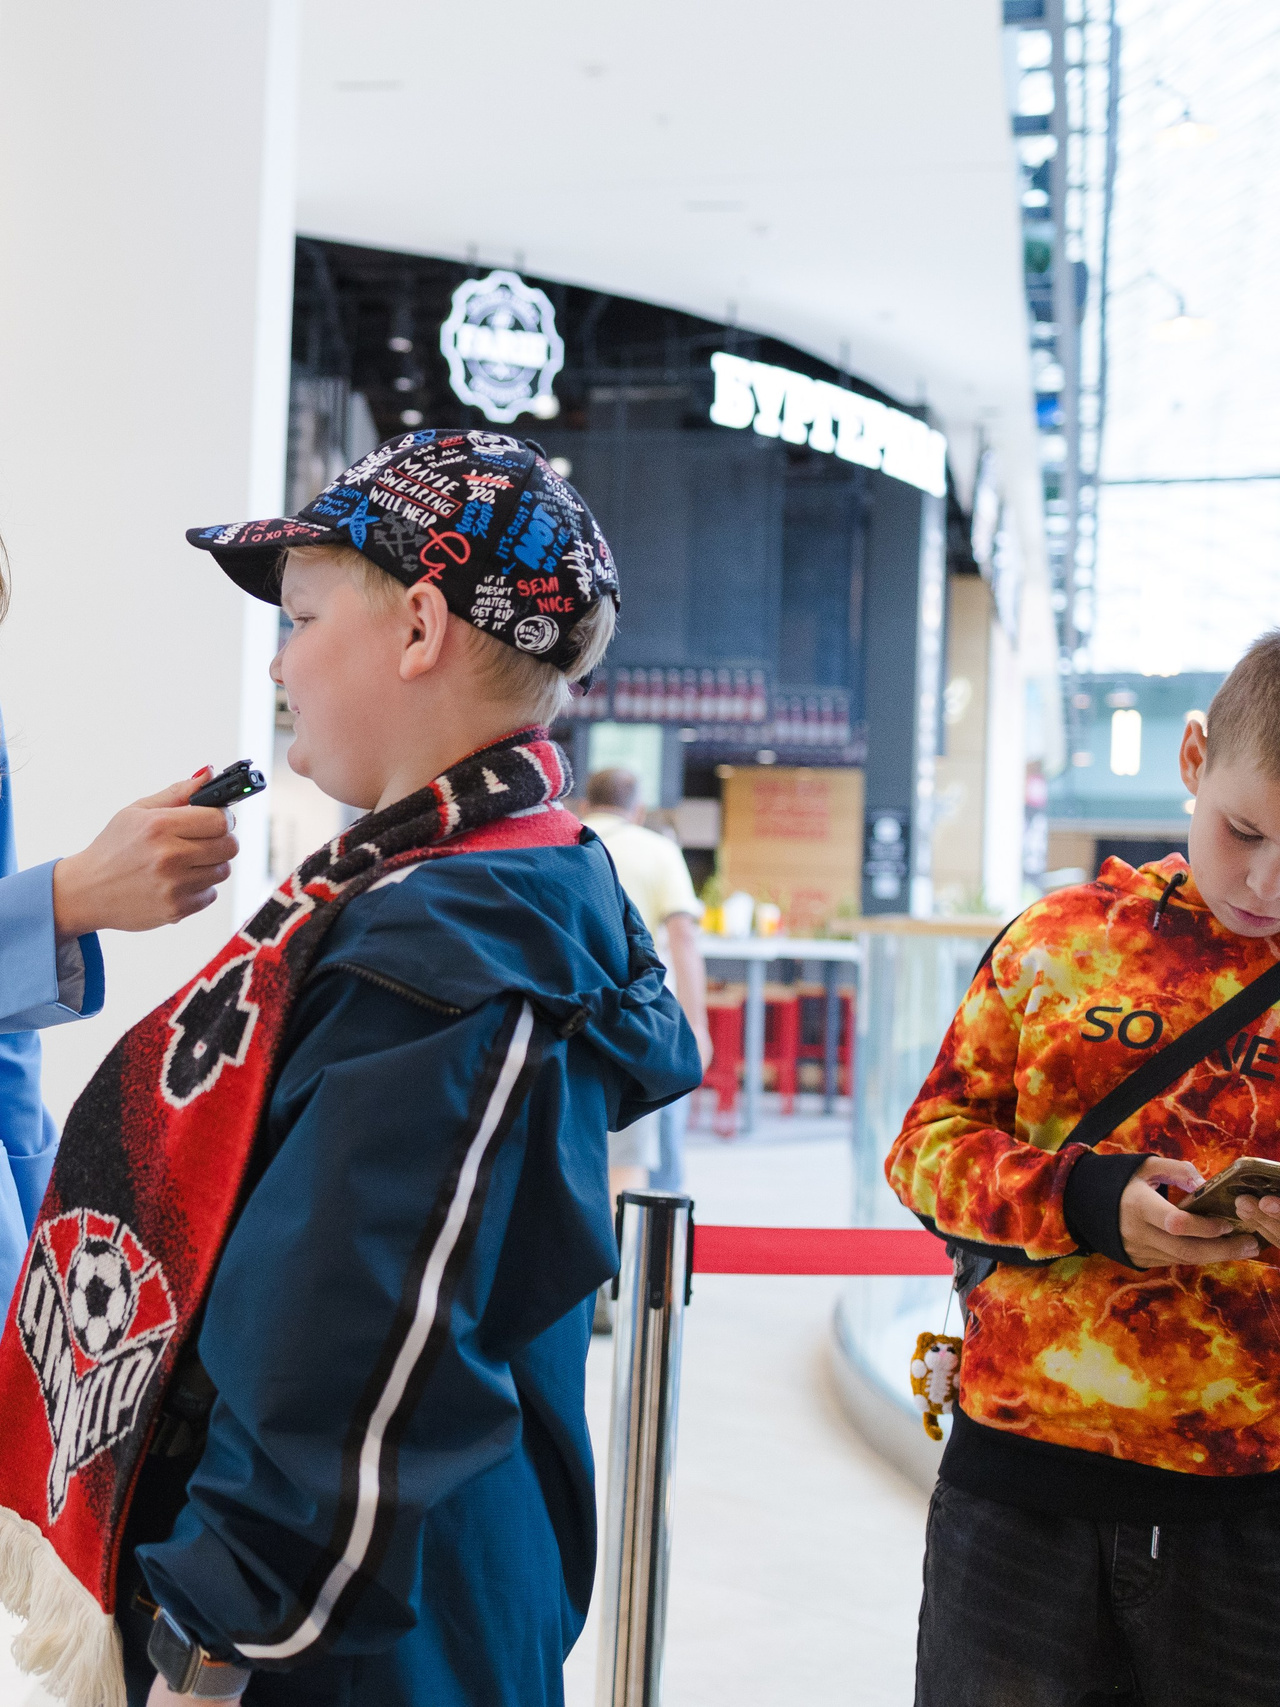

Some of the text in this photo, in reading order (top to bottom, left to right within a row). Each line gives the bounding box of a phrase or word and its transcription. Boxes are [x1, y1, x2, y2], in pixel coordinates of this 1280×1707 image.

[396, 457, 460, 496] MAYBE
[378, 468, 455, 516] SWEARING
[520, 490, 533, 504] TO
[368, 485, 402, 512] WILL
[401, 502, 437, 529] HELP
[496, 575, 507, 586] IT
[516, 576, 559, 597] SEMI
[475, 584, 514, 596] DOESN'T
[476, 597, 512, 609] MATTER
[536, 595, 575, 613] NICE
[470, 605, 514, 621] GET RID
[1080, 1005, 1164, 1050] SO
